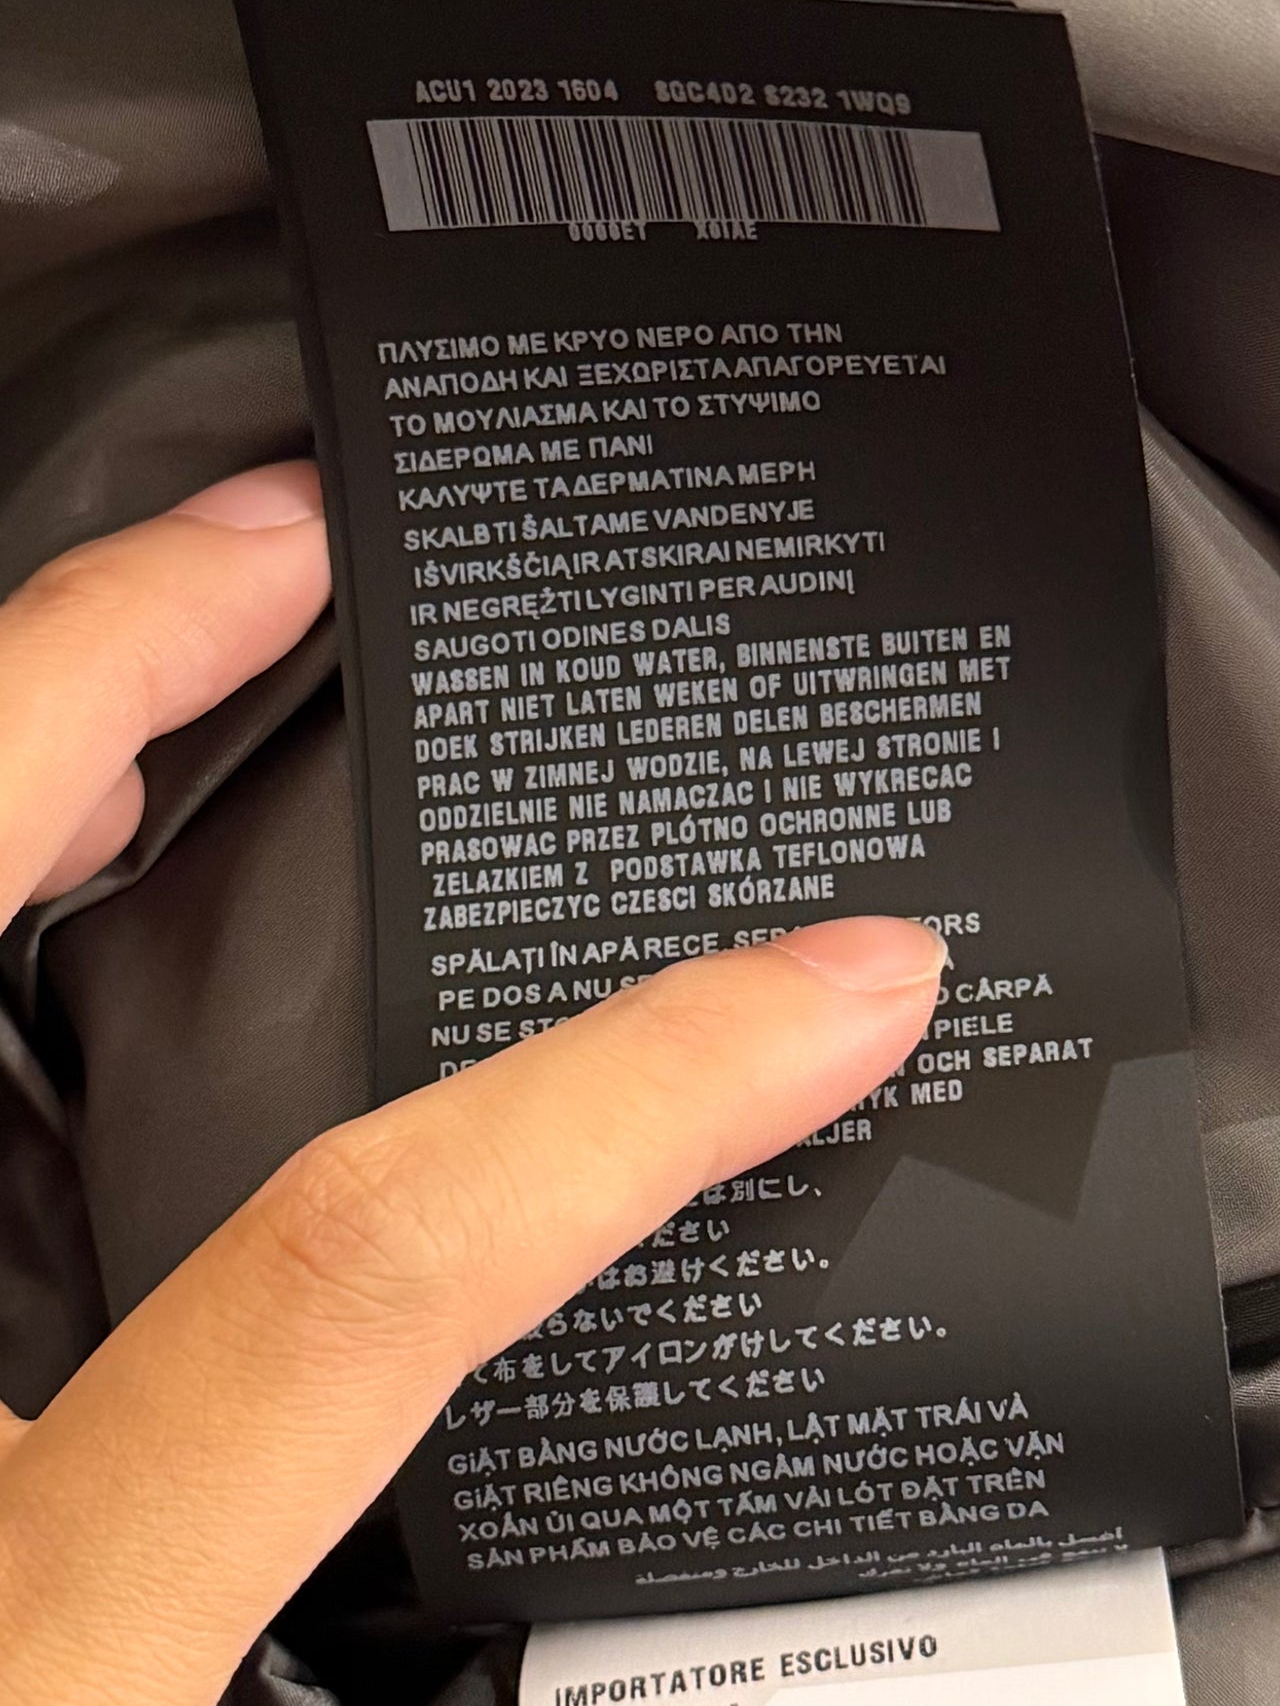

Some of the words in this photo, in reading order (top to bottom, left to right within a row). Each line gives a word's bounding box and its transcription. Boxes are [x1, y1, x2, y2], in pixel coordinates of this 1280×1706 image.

[416, 78, 476, 103] ACU1
[486, 78, 549, 102] 2023
[557, 78, 619, 102] 1604
[377, 335, 500, 365] ΠΛΥΣΙΜΟ
[553, 328, 629, 353] ΚΡΥΟ
[636, 324, 714, 349] ΝΕΡΟ
[720, 323, 779, 345] ΑΠΟ
[786, 323, 843, 344] ΤΗΝ
[384, 369, 518, 401] ΑΝΑΠΟΔΗ
[523, 365, 568, 390] ΚΑΙ
[389, 413, 427, 438] ΤΟ
[433, 401, 599, 434] ΜΟΥΛΙΑΣΜΑ
[602, 397, 648, 422] ΚΑΙ
[652, 395, 690, 419] ΤΟ
[697, 390, 821, 416] ΣΤΥΨΙΜΟ
[393, 442, 535, 474] ΣΙΔΕΡΩΜΑ
[540, 438, 581, 463] ΜΕ
[588, 434, 653, 459] ΠΑΝΙ
[398, 478, 528, 512] ΚΑΛΥΨΤΕ
[737, 460, 816, 485] ΜΕΡΗ
[652, 498, 815, 530] VANDENYJE
[735, 531, 885, 562] NEMIRKYTI
[410, 603, 438, 626] IR
[698, 575, 756, 601] PER
[414, 629, 536, 662] SAUGOTI
[541, 620, 646, 650] ODINES
[651, 612, 731, 641] DALIS
[410, 664, 510, 696] WASSEN
[520, 661, 545, 687] IN
[555, 654, 621, 684] KOUD
[632, 646, 726, 677] WATER,
[736, 633, 871, 668] BINNENSTE
[881, 627, 968, 656] BUITEN
[979, 624, 1011, 649] EN
[414, 699, 490, 730] APART
[500, 693, 555, 722] NIET
[566, 685, 642, 716] LATEN
[653, 677, 738, 708] WEKEN
[749, 672, 782, 700] OF
[793, 660, 947, 696] UITWRINGEN
[958, 656, 1011, 683] MET
[414, 733, 479, 763] DOEK
[489, 722, 606, 756] STRIJKEN
[617, 712, 722, 746] LEDEREN
[733, 704, 809, 736] DELEN
[819, 691, 982, 728] BESCHERMEN
[417, 770, 481, 800] PRAC
[490, 767, 514, 793] W
[524, 759, 615, 790] ZIMNEJ
[626, 749, 729, 781] WODZIE,
[739, 745, 774, 772] NA
[783, 737, 865, 768] LEWEJ
[876, 727, 981, 760] STRONIE
[992, 726, 1000, 751] I
[419, 796, 558, 832] ODDZIELNIE
[568, 792, 608, 820] NIE
[618, 780, 754, 816] NAMACZAC
[764, 778, 772, 804] I
[782, 774, 822, 802] NIE
[833, 762, 973, 797] WYKRECAC
[420, 831, 557, 866] PRASOWAC
[566, 824, 640, 854] PRZEZ
[759, 802, 896, 837] OCHRONNE
[907, 797, 952, 826] LUB
[432, 863, 564, 897] ZELAZKIEM
[574, 861, 589, 886] Z
[610, 846, 762, 883] PODSTAWKA
[772, 833, 926, 869] TEFLONOWA
[423, 893, 601, 932] ZABEZPIECZYC
[611, 885, 696, 915] CZESCI
[438, 988, 475, 1012] PE
[482, 983, 541, 1008] DOS
[547, 981, 568, 1003] A
[573, 977, 617, 1005] NU
[431, 1024, 470, 1047] NU
[475, 1020, 512, 1043] SE
[934, 1012, 1014, 1040] PIELE
[917, 1049, 971, 1074] OCH
[982, 1037, 1094, 1068] SEPARAT
[910, 1079, 963, 1105] MED
[580, 1507, 644, 1530] QUA
[793, 1518, 842, 1538] CHI
[780, 1635, 937, 1678] ESCLUSIVO
